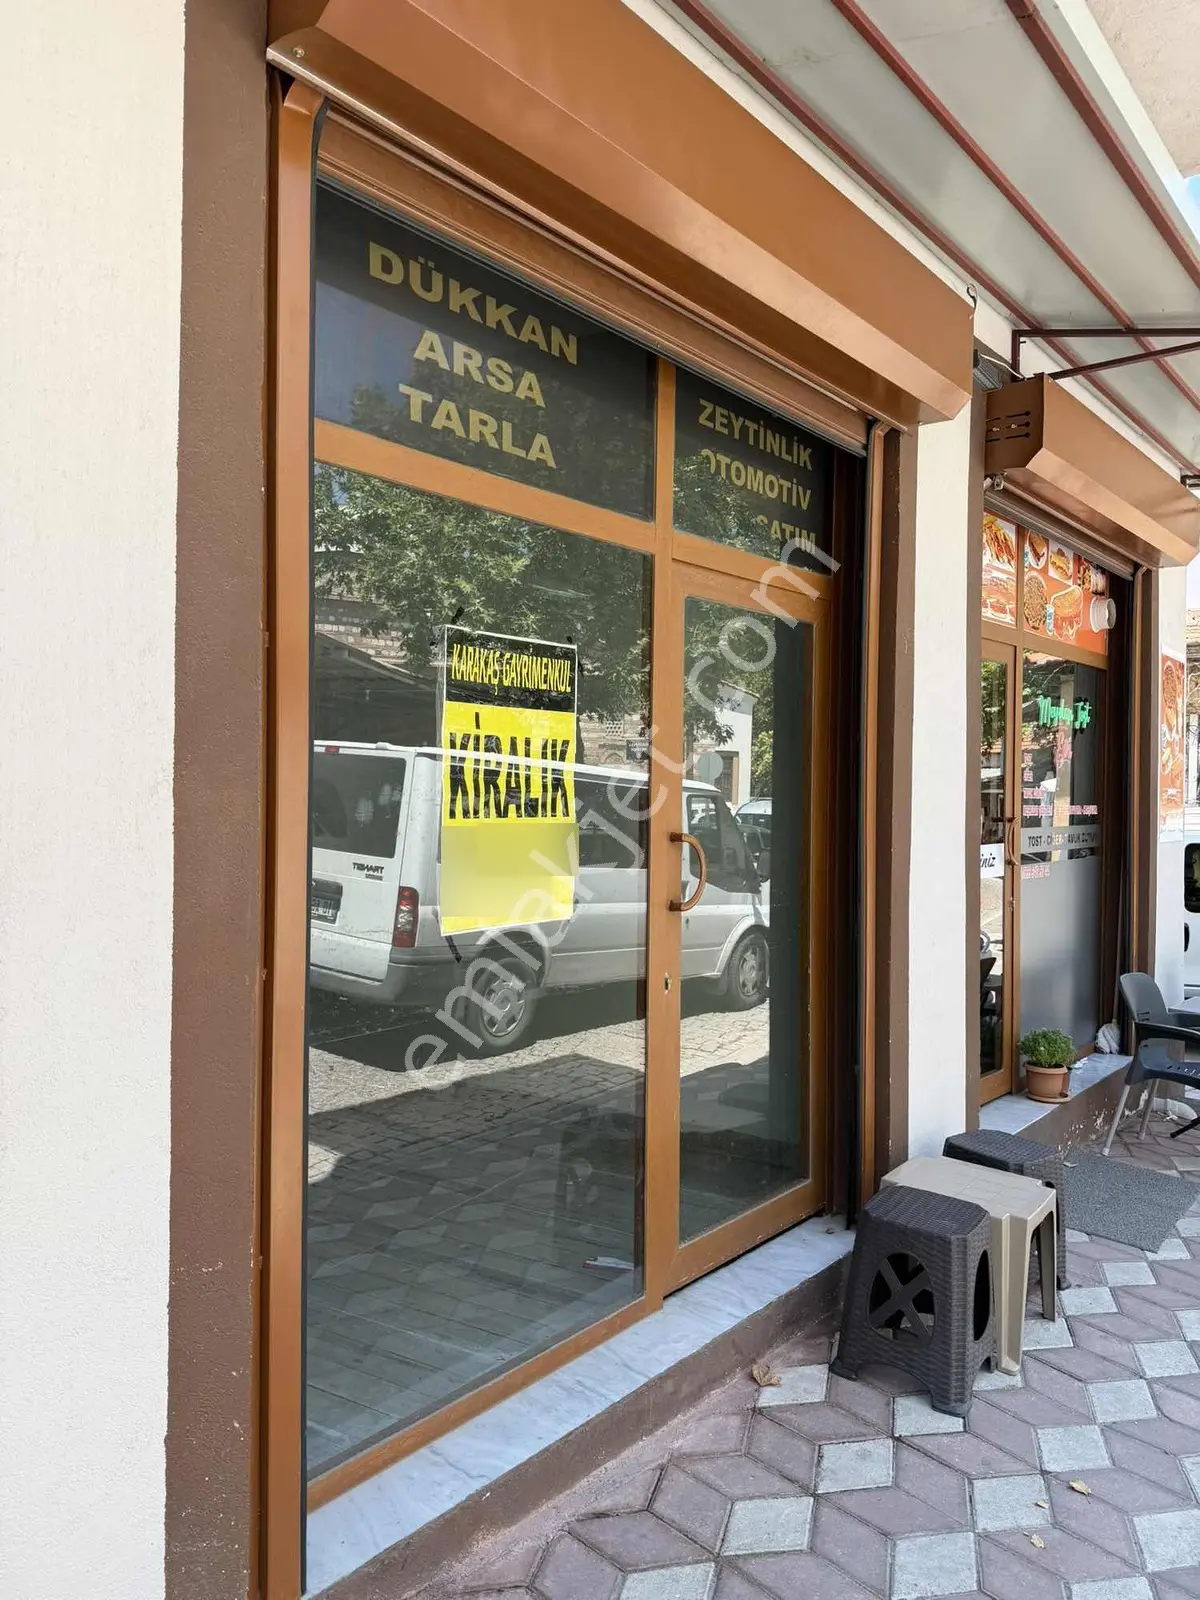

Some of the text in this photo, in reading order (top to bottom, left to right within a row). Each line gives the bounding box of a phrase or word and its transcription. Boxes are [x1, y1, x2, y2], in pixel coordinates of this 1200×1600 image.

[369, 241, 578, 365] DÜKKAN
[413, 330, 547, 408] ARSA
[399, 383, 557, 469] TARLA
[698, 398, 813, 471] ZEYTİNLİK
[451, 643, 571, 695] KARAKAŞ GAYRİMENKUL
[448, 711, 571, 819] KİRALIK
[1028, 835, 1042, 847] TOST
